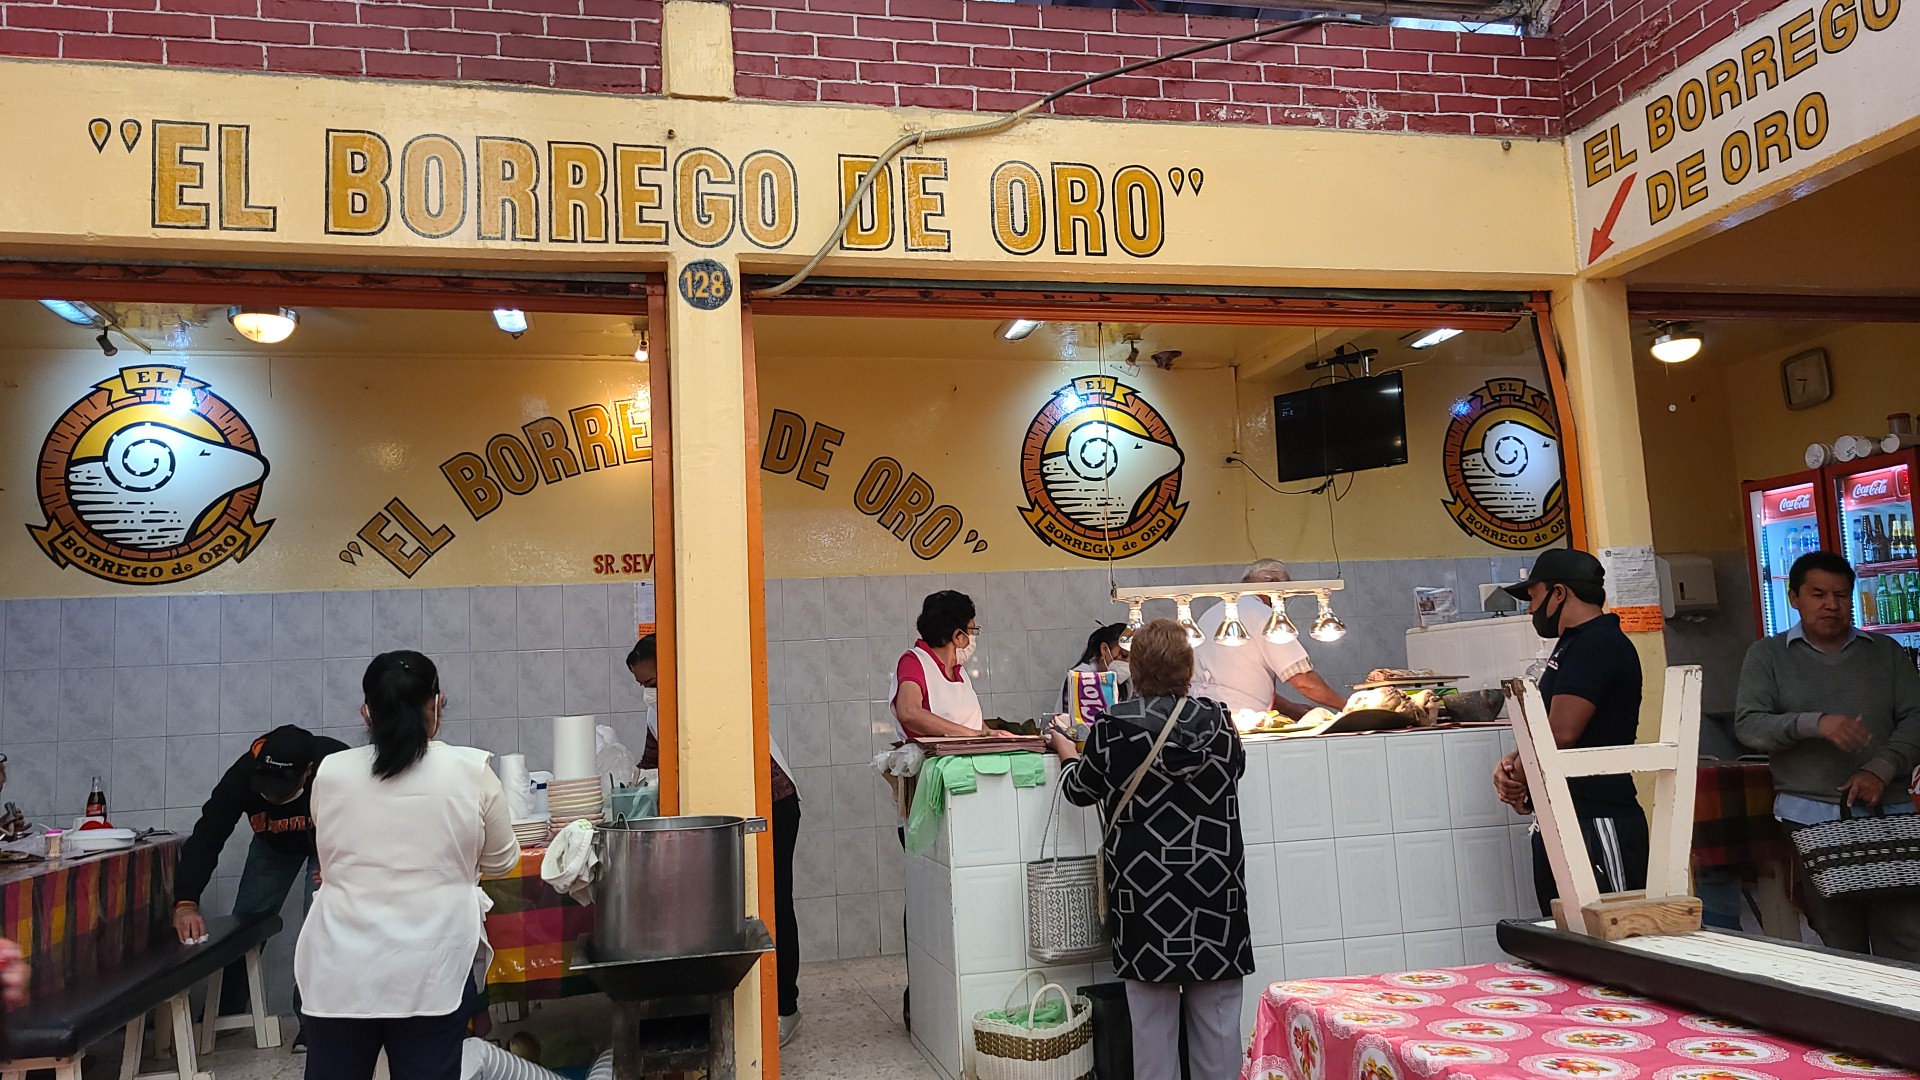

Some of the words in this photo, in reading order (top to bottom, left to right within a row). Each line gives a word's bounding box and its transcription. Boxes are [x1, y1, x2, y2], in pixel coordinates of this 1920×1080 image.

[1583, 123, 1638, 188] EL
[1646, 149, 1709, 225] DE
[1721, 92, 1830, 186] ORO
[323, 128, 798, 249] BORREGO
[837, 152, 951, 253] DE
[683, 270, 726, 298] 128
[137, 371, 169, 384] EL
[1085, 380, 1106, 390] EL
[1497, 382, 1517, 392] EL
[759, 408, 846, 490] DE
[1044, 521, 1115, 554] BORREGO
[1122, 541, 1138, 552] de
[1141, 518, 1166, 542] ORO
[1465, 513, 1527, 545] BORREGO
[1534, 533, 1547, 543] de
[62, 535, 164, 579] BORREGO
[171, 562, 193, 576] de
[198, 534, 239, 566] ORO
